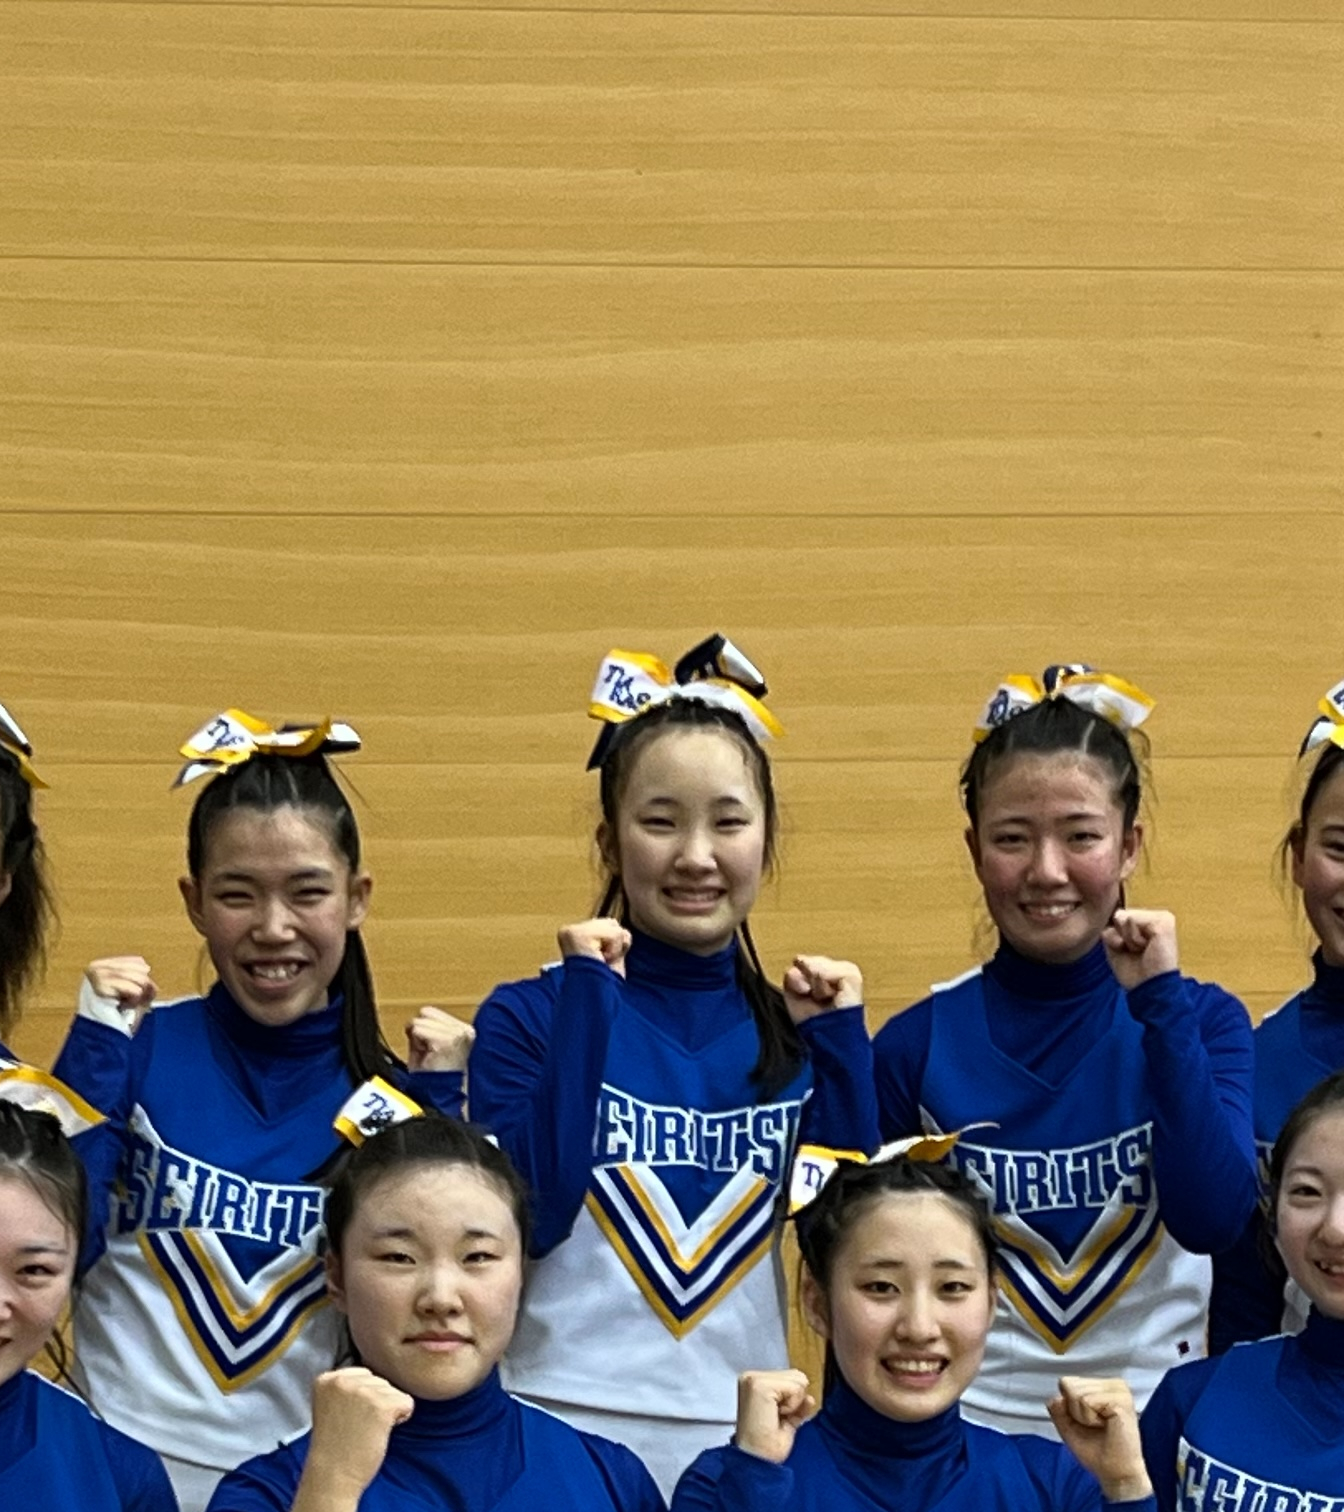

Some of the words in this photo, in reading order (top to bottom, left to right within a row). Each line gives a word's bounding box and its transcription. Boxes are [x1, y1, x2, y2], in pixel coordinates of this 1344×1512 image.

[114, 1130, 325, 1248] SEIRIT
[593, 1084, 803, 1192] EIRITS
[955, 1132, 1154, 1216] EIRITS
